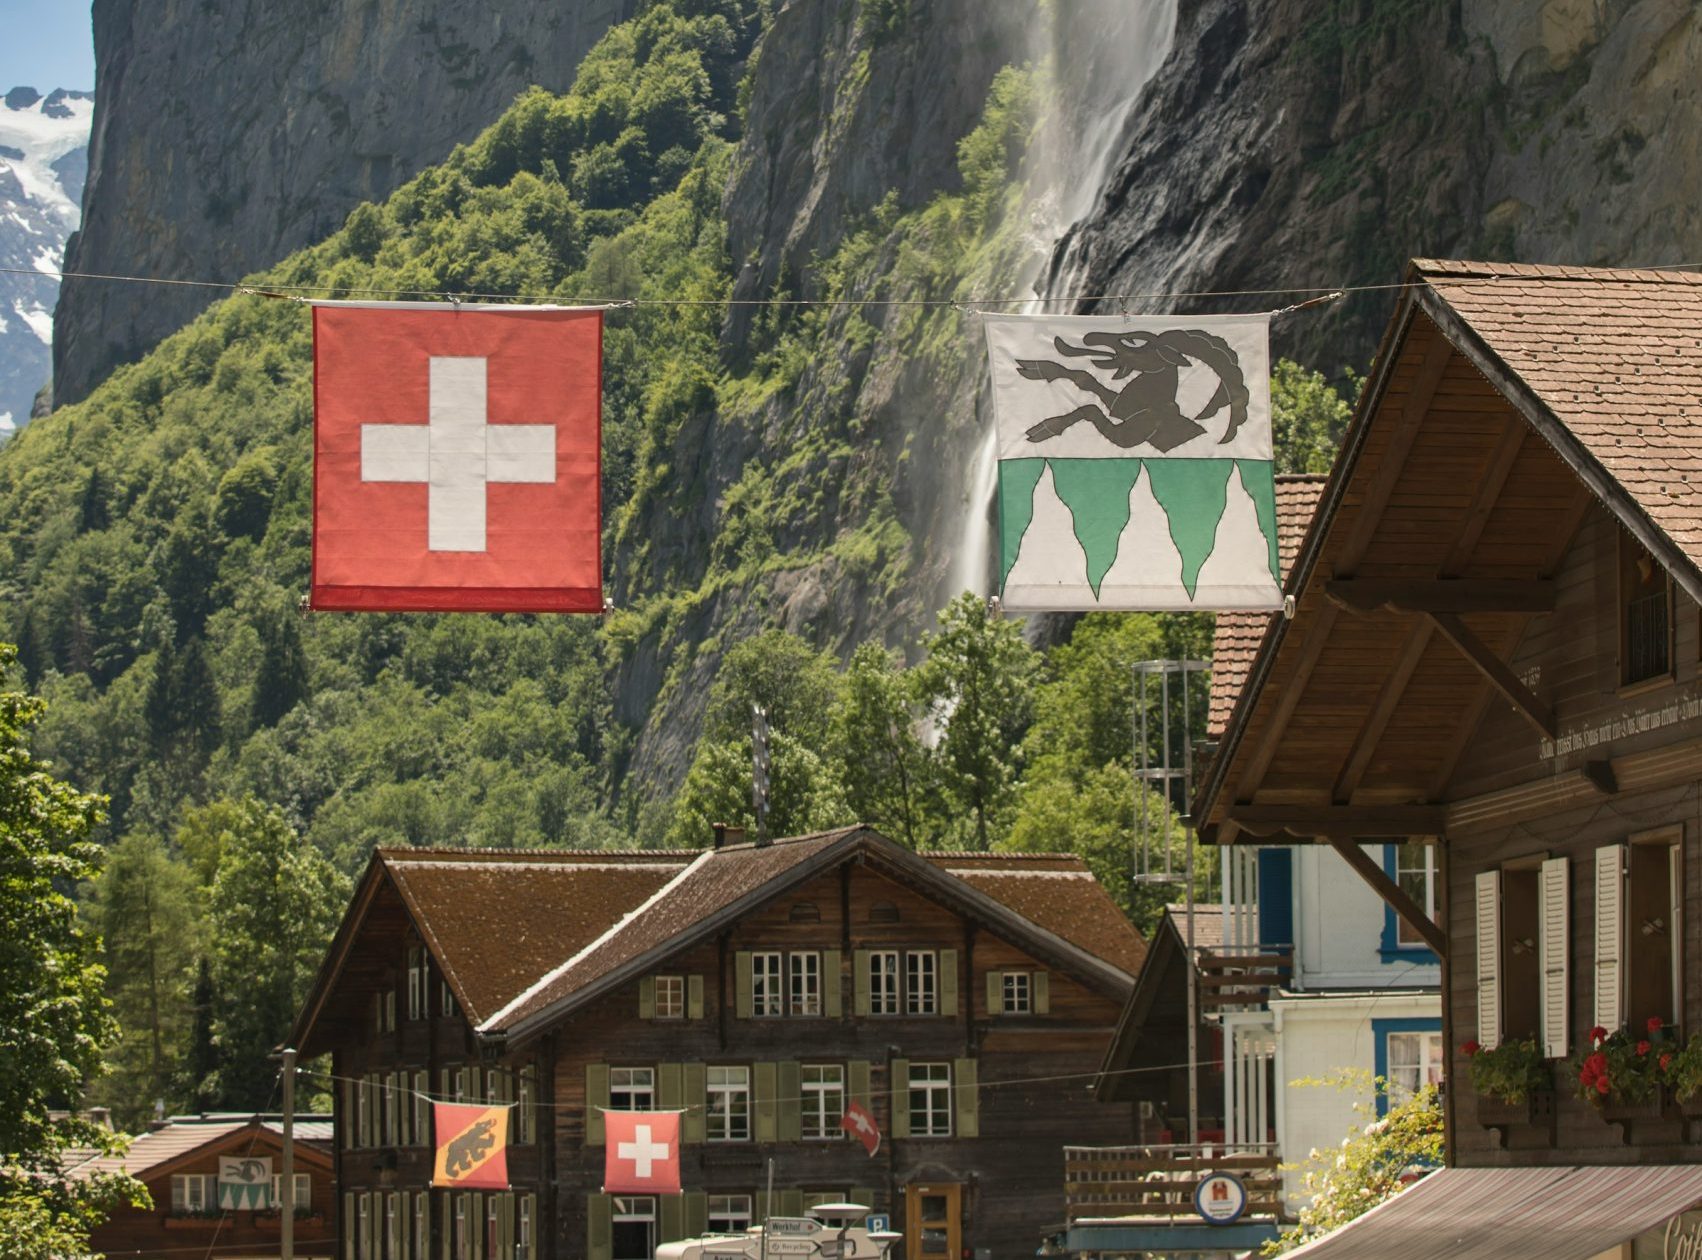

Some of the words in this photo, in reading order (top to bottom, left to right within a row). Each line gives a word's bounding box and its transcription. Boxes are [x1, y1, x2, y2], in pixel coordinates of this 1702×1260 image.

[772, 1222, 801, 1231] Werkhof
[873, 1218, 883, 1232] P
[1664, 1215, 1702, 1260] Coif
[782, 1241, 811, 1251] Recycling
